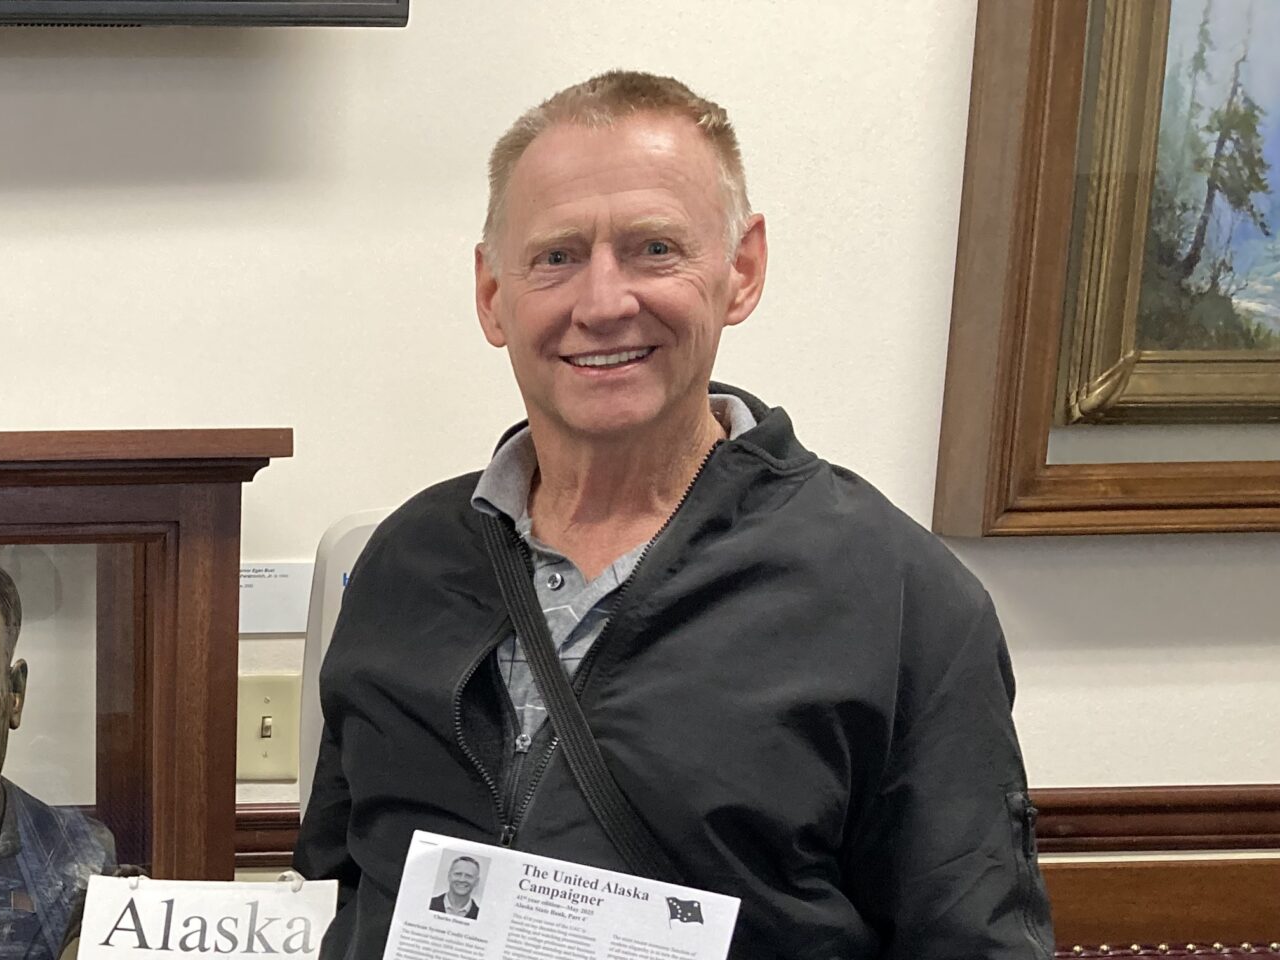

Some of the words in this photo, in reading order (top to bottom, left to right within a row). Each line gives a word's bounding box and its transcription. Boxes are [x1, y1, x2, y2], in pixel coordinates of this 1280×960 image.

[518, 878, 604, 906] Campaigner
[523, 863, 549, 880] The
[553, 869, 599, 890] United
[601, 881, 650, 901] Alaska
[99, 896, 315, 955] Alaska
[515, 902, 534, 911] Alaska
[535, 906, 549, 914] State
[568, 913, 580, 921] Part
